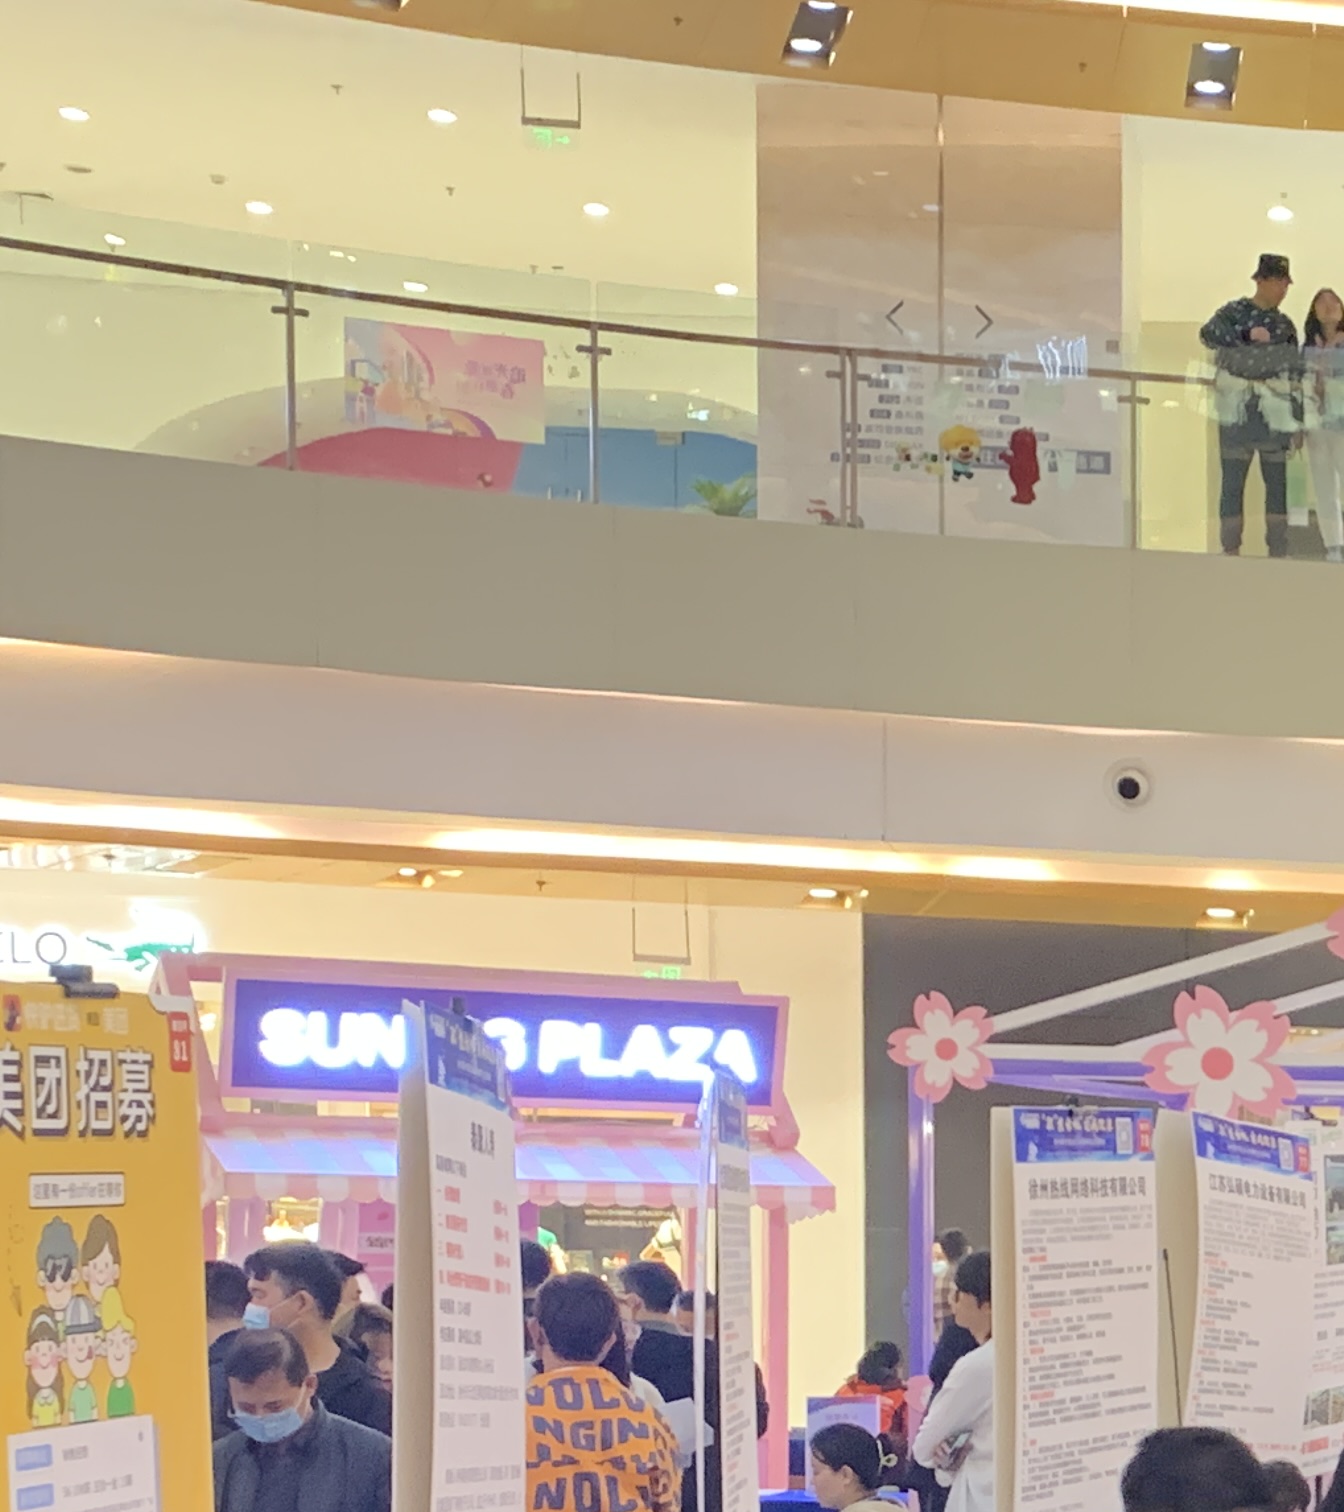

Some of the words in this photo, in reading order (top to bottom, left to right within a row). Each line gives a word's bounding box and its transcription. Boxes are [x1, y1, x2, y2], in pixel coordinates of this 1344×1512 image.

[0, 931, 67, 965] LO
[538, 1018, 758, 1084] PLAZA
[0, 1038, 155, 1140] 美团招募
